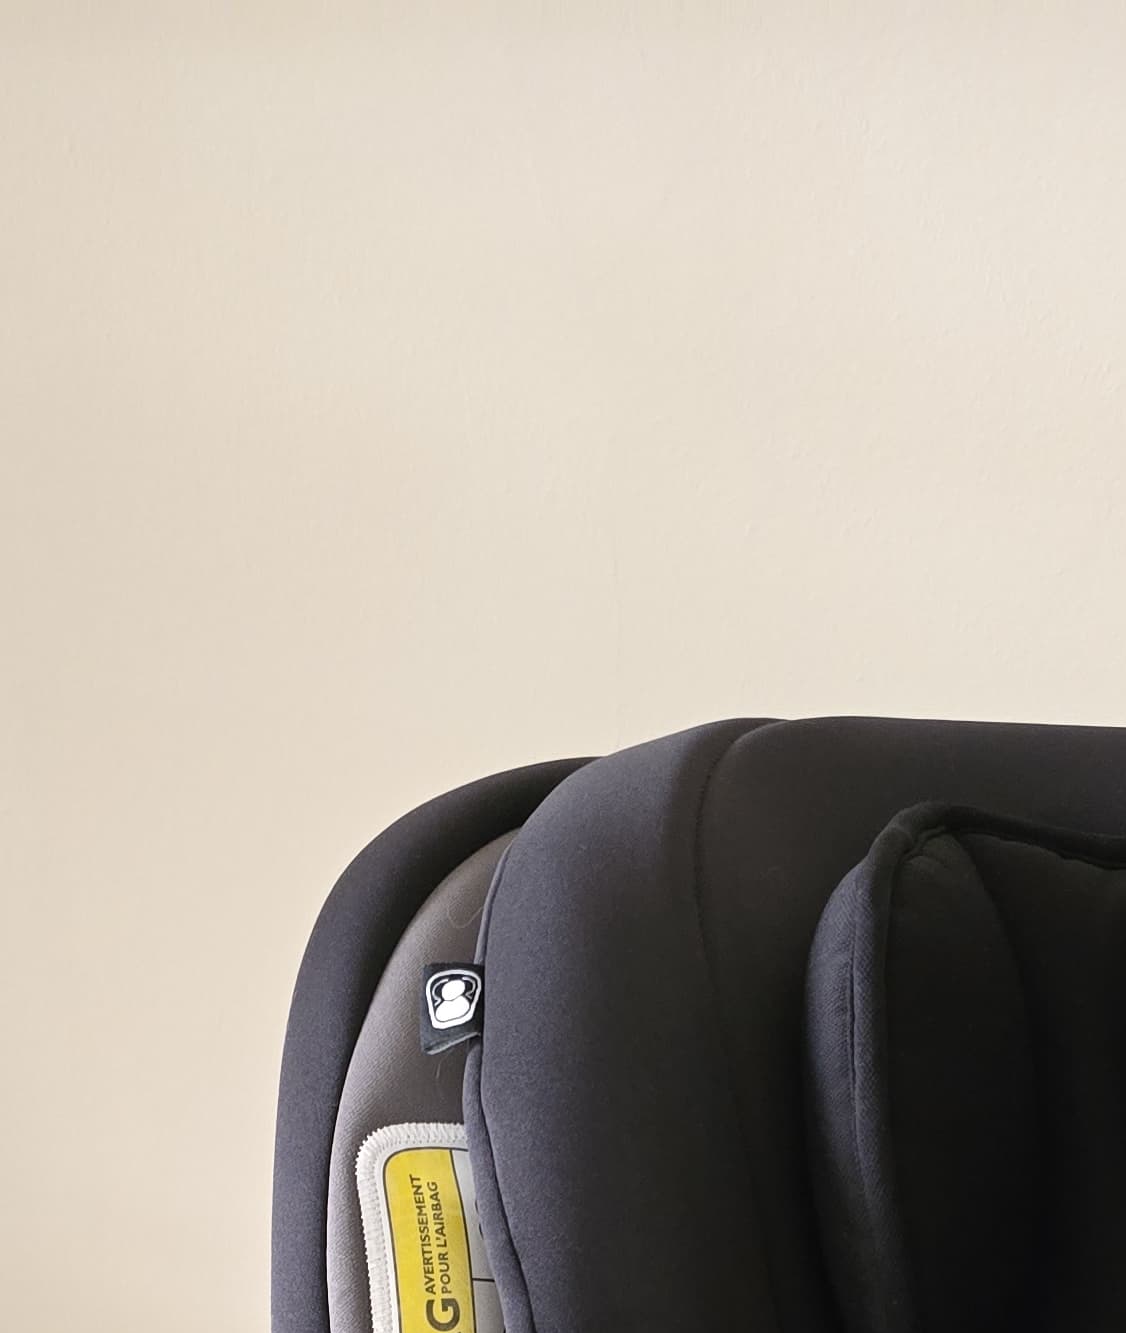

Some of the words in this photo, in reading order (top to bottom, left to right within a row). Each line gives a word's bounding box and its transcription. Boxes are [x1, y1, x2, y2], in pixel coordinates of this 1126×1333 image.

[408, 1173, 437, 1295] AVERTISSEMENT
[426, 1180, 448, 1249] L'AIRBAG
[437, 1251, 453, 1294] POUR
